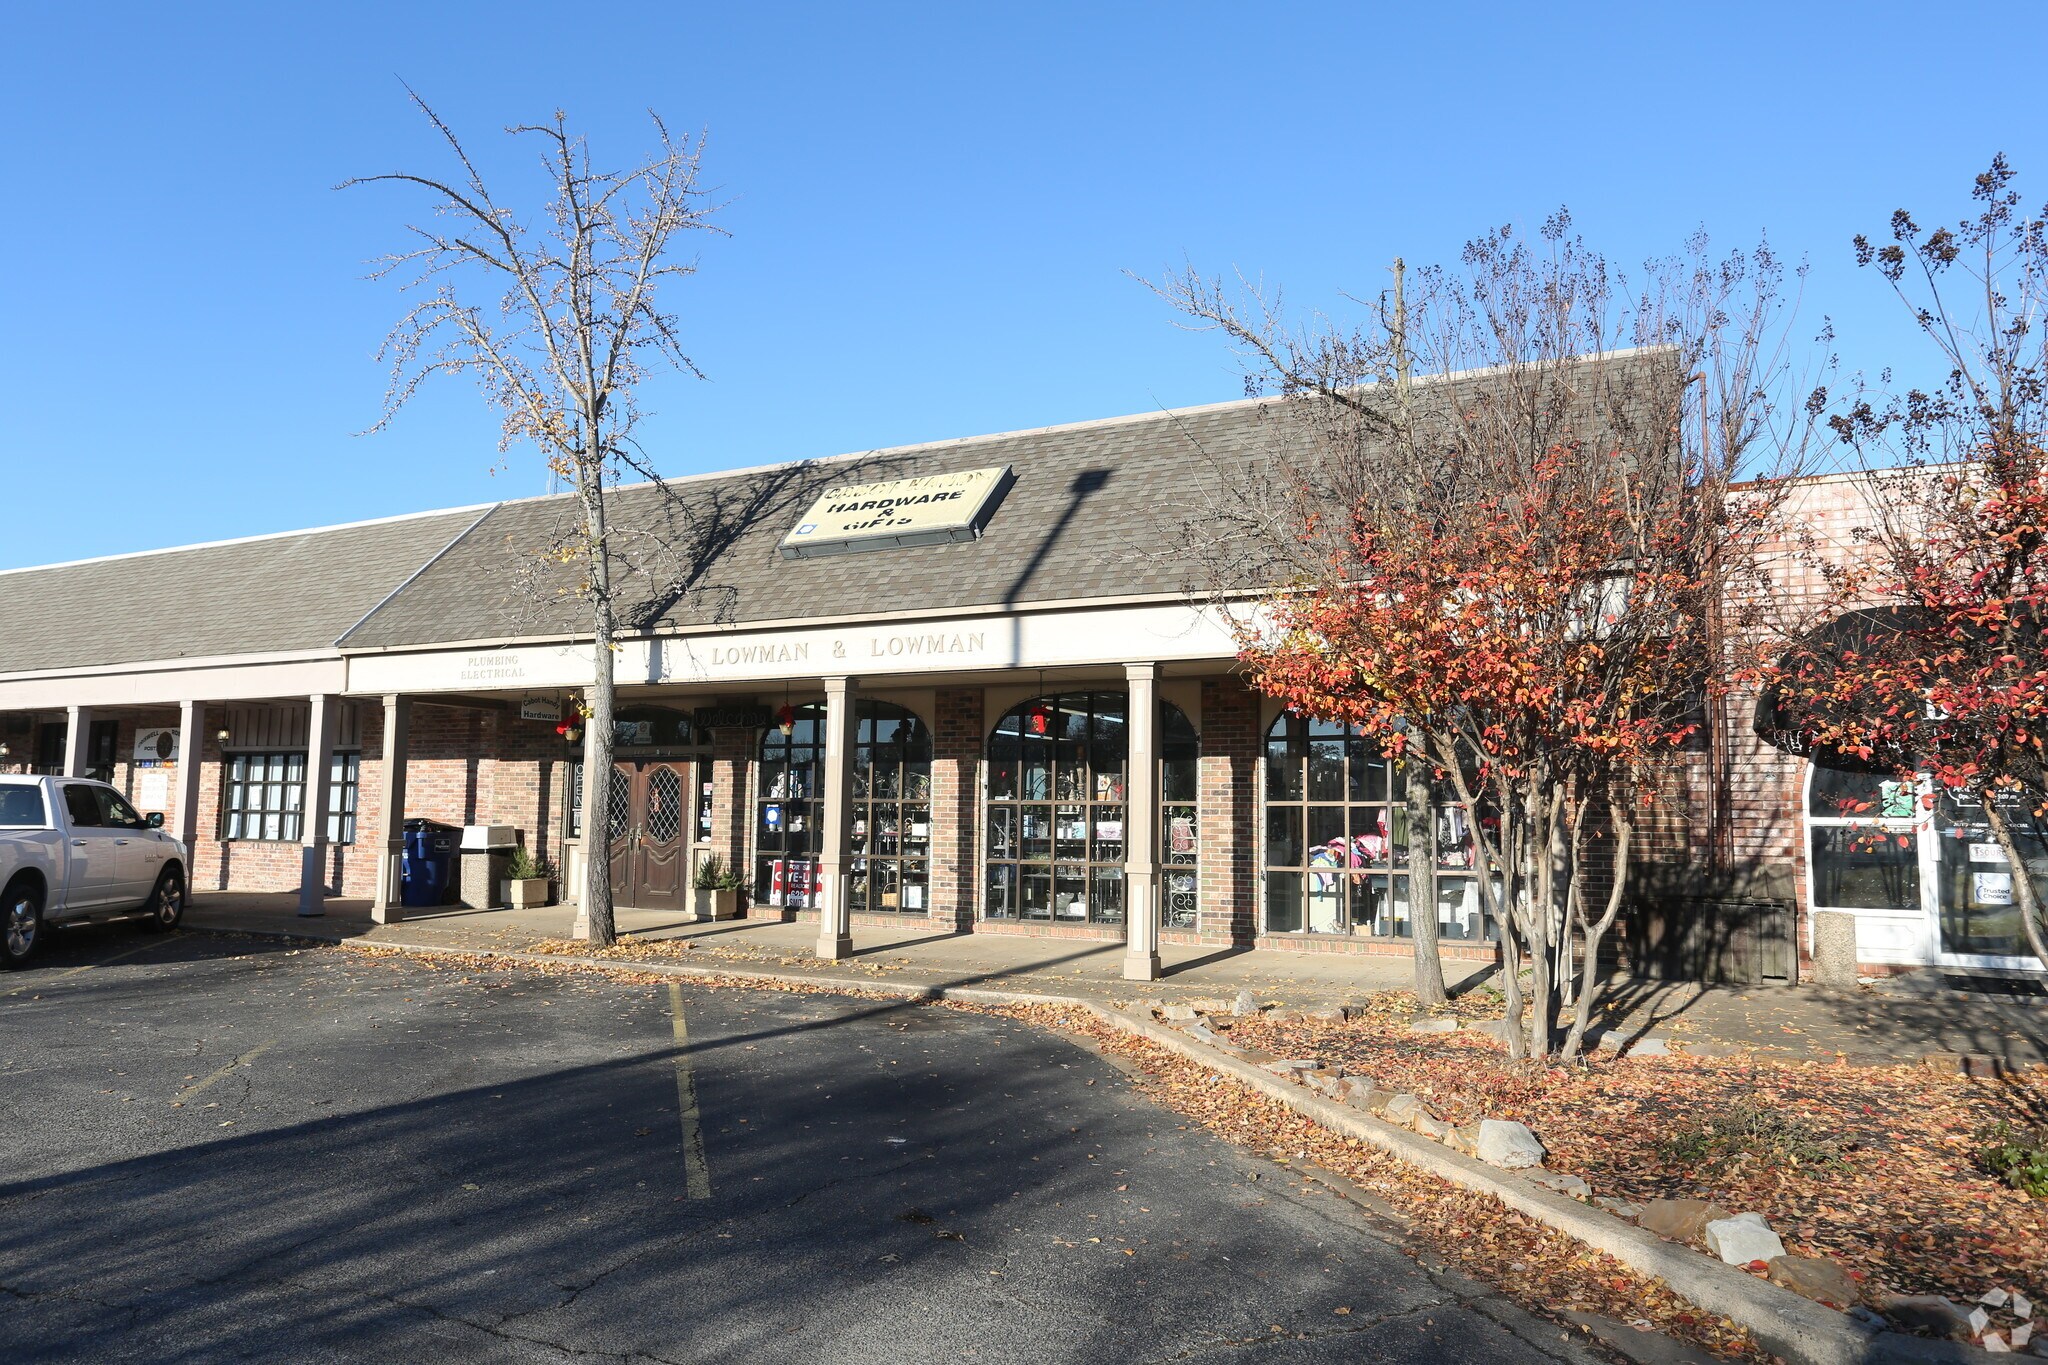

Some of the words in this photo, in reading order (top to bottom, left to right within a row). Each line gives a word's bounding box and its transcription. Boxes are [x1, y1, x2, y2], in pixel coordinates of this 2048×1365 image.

[826, 490, 966, 513] HARDWARE
[877, 508, 895, 518] &
[711, 642, 809, 665] LOWMAN
[832, 640, 847, 658] &
[871, 632, 985, 657] LOWMAN
[468, 655, 519, 667] PLUMBING
[461, 668, 525, 680] ELECTRICAL
[522, 697, 541, 707] Cabot
[541, 697, 560, 710] Handy
[523, 710, 560, 720] Hardware
